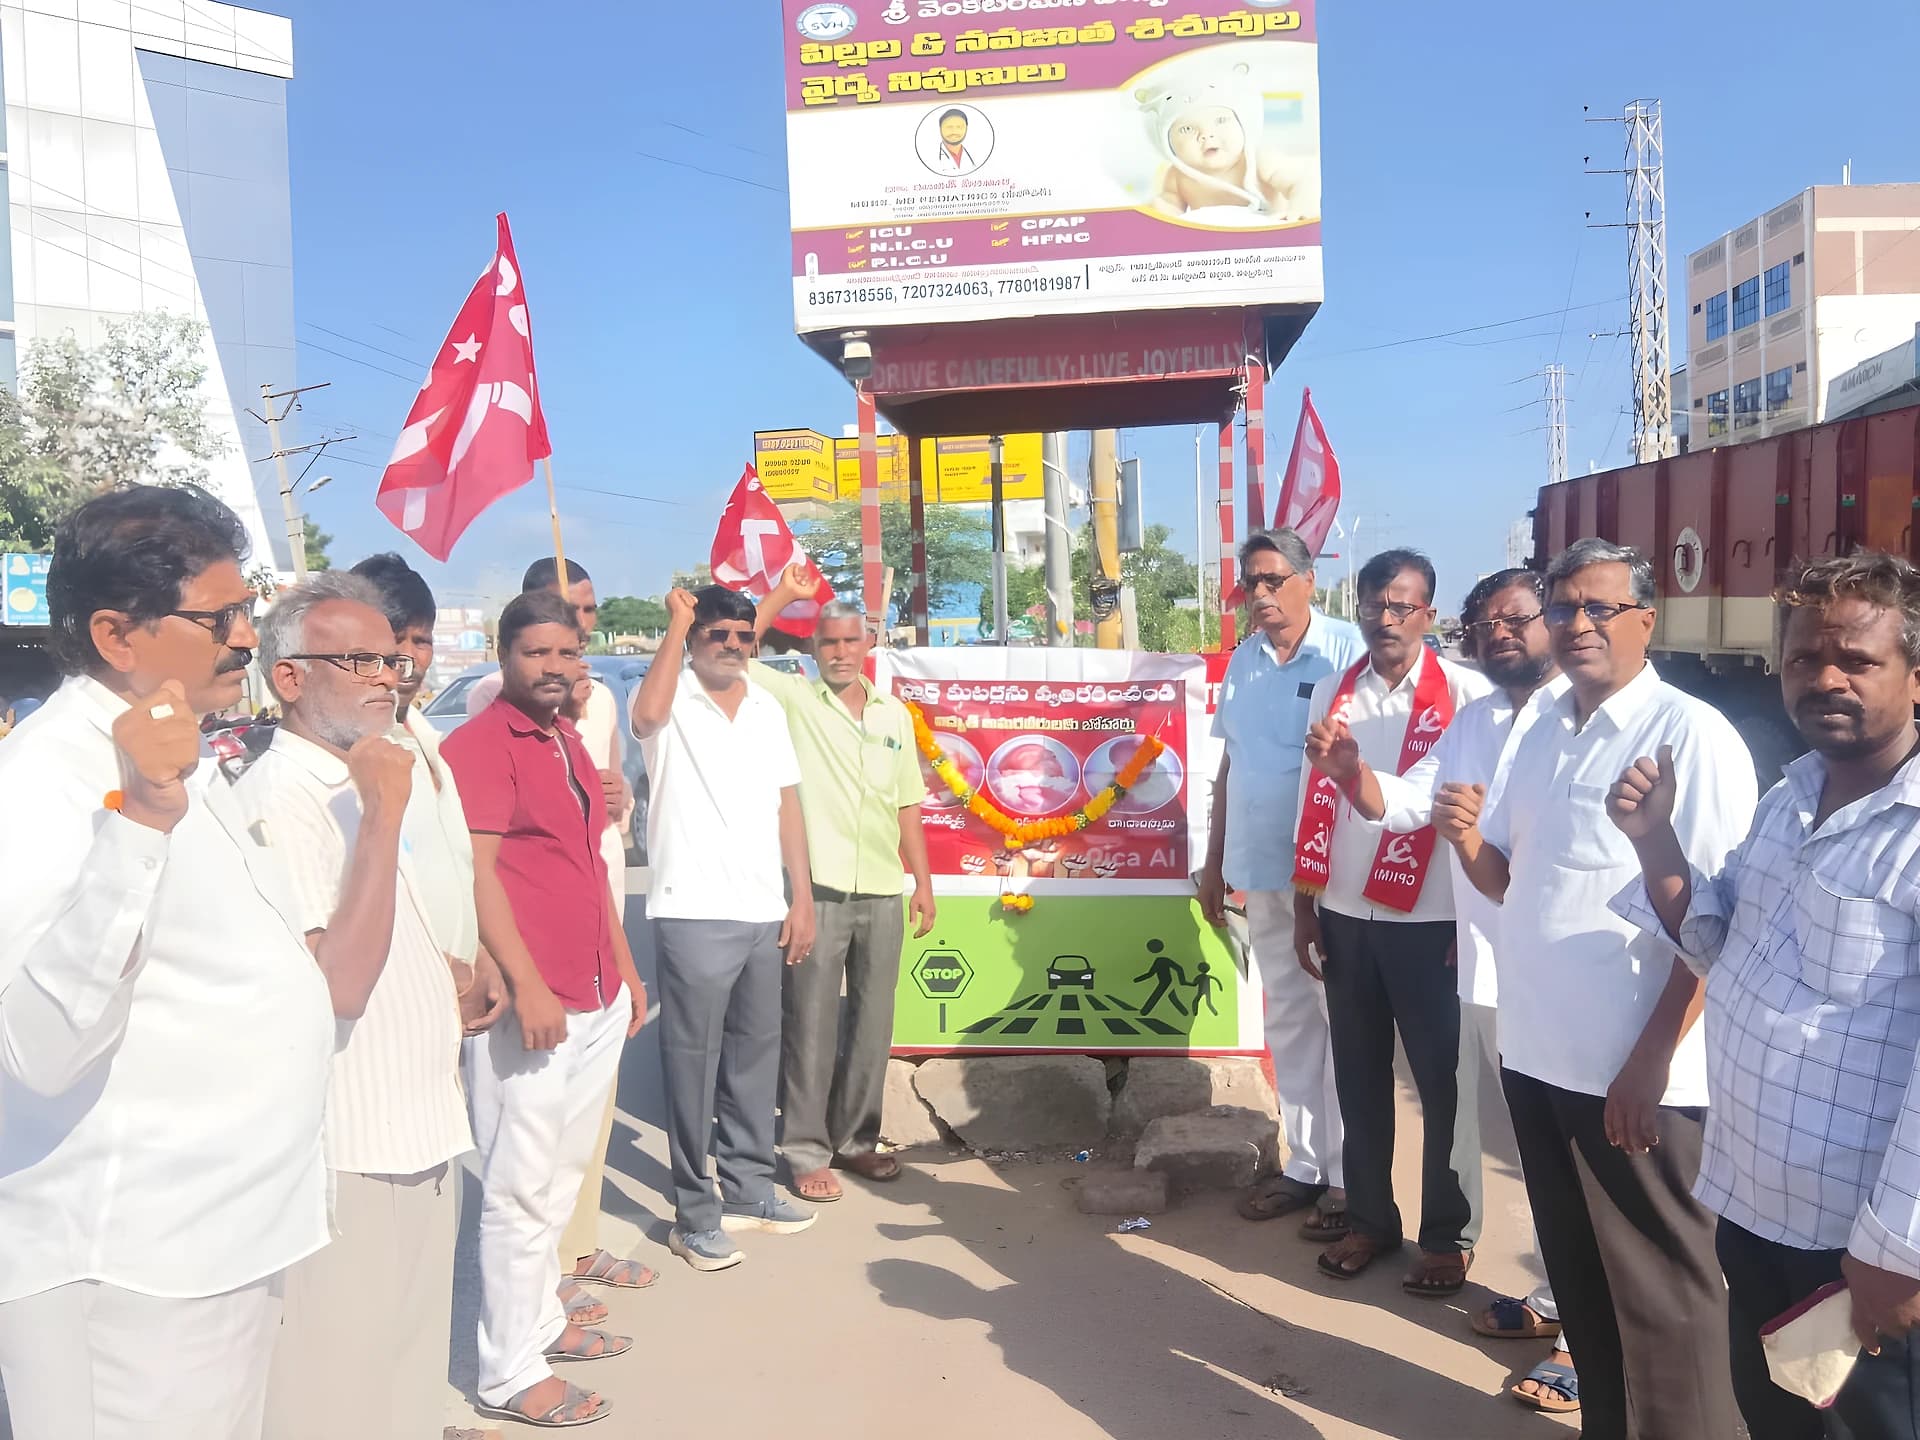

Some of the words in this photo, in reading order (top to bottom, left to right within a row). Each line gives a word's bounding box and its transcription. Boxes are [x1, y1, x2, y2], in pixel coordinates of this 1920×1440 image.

[811, 20, 843, 32] SVH
[955, 20, 1116, 53] నవజాత
[1125, 10, 1301, 39] శిశువుల
[809, 287, 897, 305] 8367318556,
[902, 281, 993, 300] 7207324063,
[998, 276, 1081, 294] 7780181987
[872, 360, 937, 390] DRIVE
[1081, 351, 1128, 379] LIVE
[1138, 343, 1245, 375] JOYFULLY
[922, 968, 963, 980] STOP
